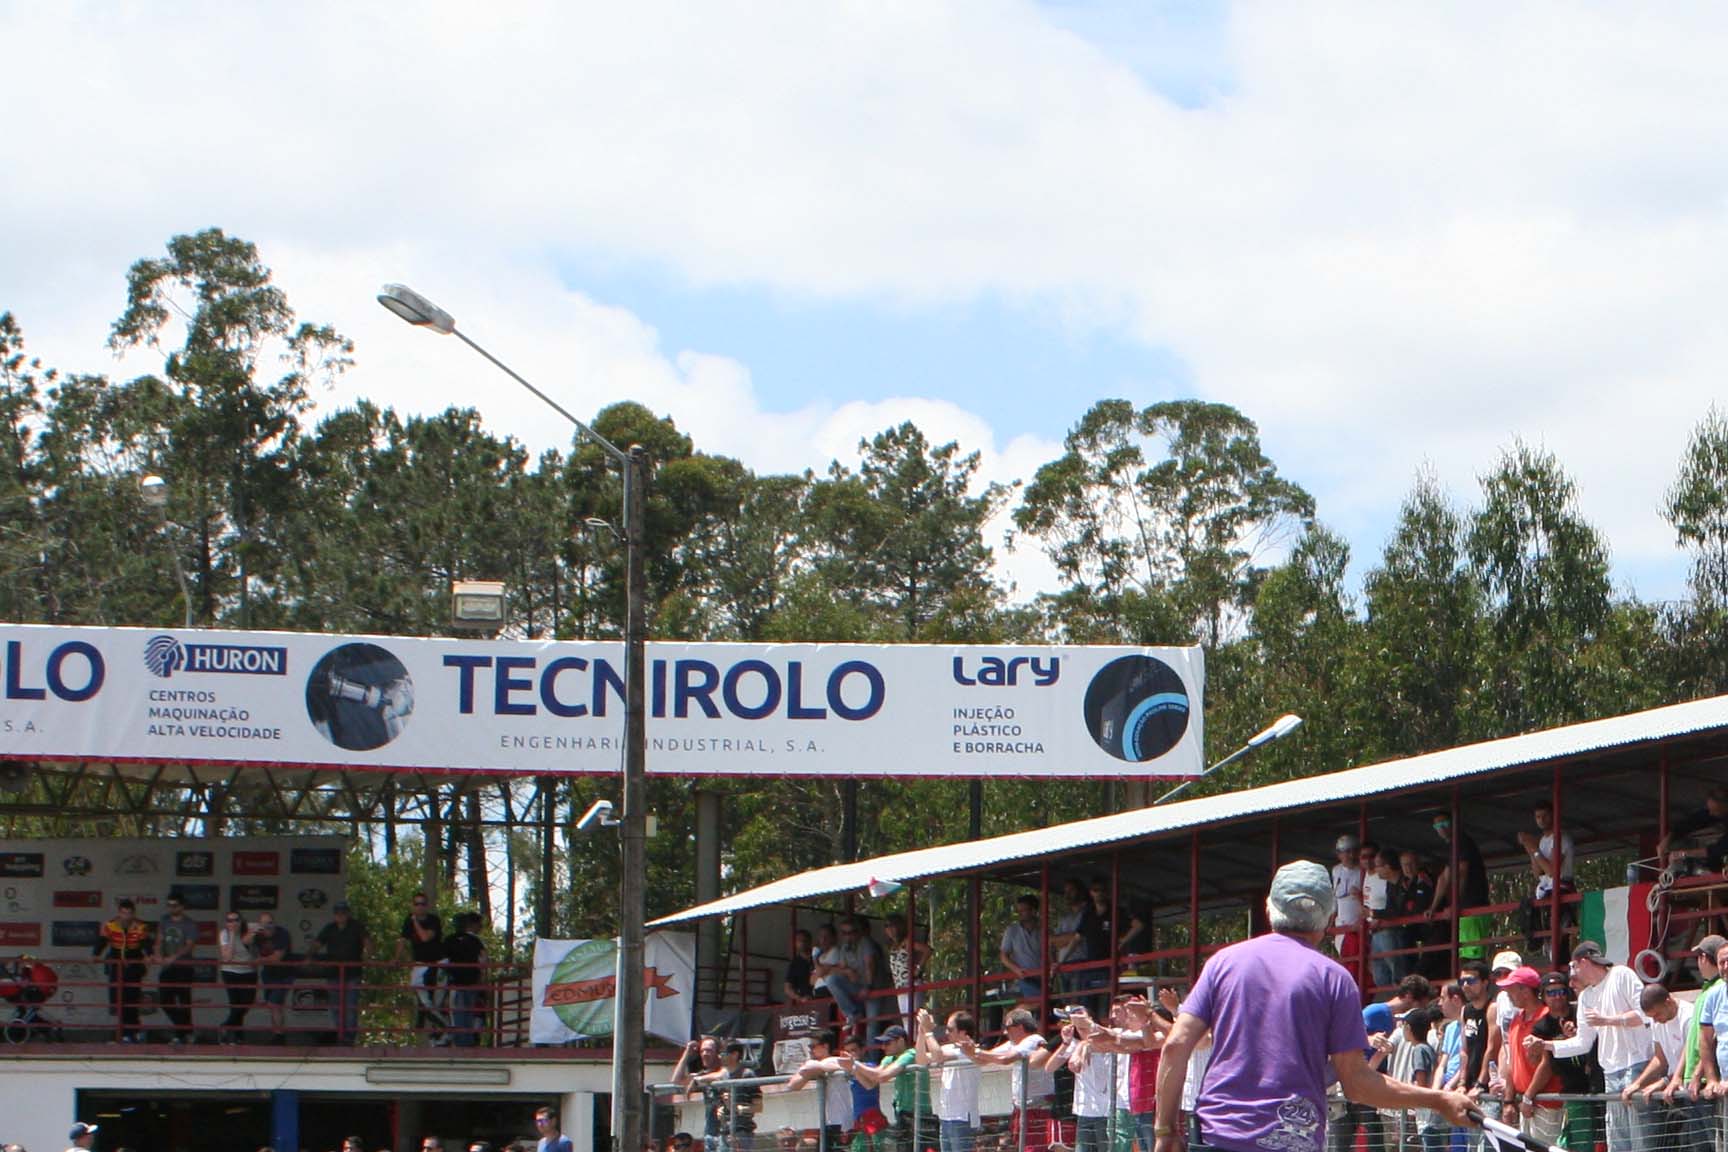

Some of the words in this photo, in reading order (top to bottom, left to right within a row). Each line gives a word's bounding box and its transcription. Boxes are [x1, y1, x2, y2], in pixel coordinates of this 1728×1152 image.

[194, 648, 280, 672] HURON
[0, 640, 105, 703] LO
[443, 654, 886, 721] TECNIROLO
[149, 690, 216, 703] CENTROS
[149, 706, 250, 723] MAQUINAÇÃO
[953, 704, 1015, 722] INJEÇÃO
[148, 724, 185, 738] ALTA
[188, 726, 281, 740] VELOCIDADE
[953, 722, 1022, 737] PLÁSTICO
[500, 735, 625, 750] ENGENHARI
[786, 740, 826, 753] S.A.
[953, 742, 961, 753] E
[965, 742, 1044, 754] BORRACHA
